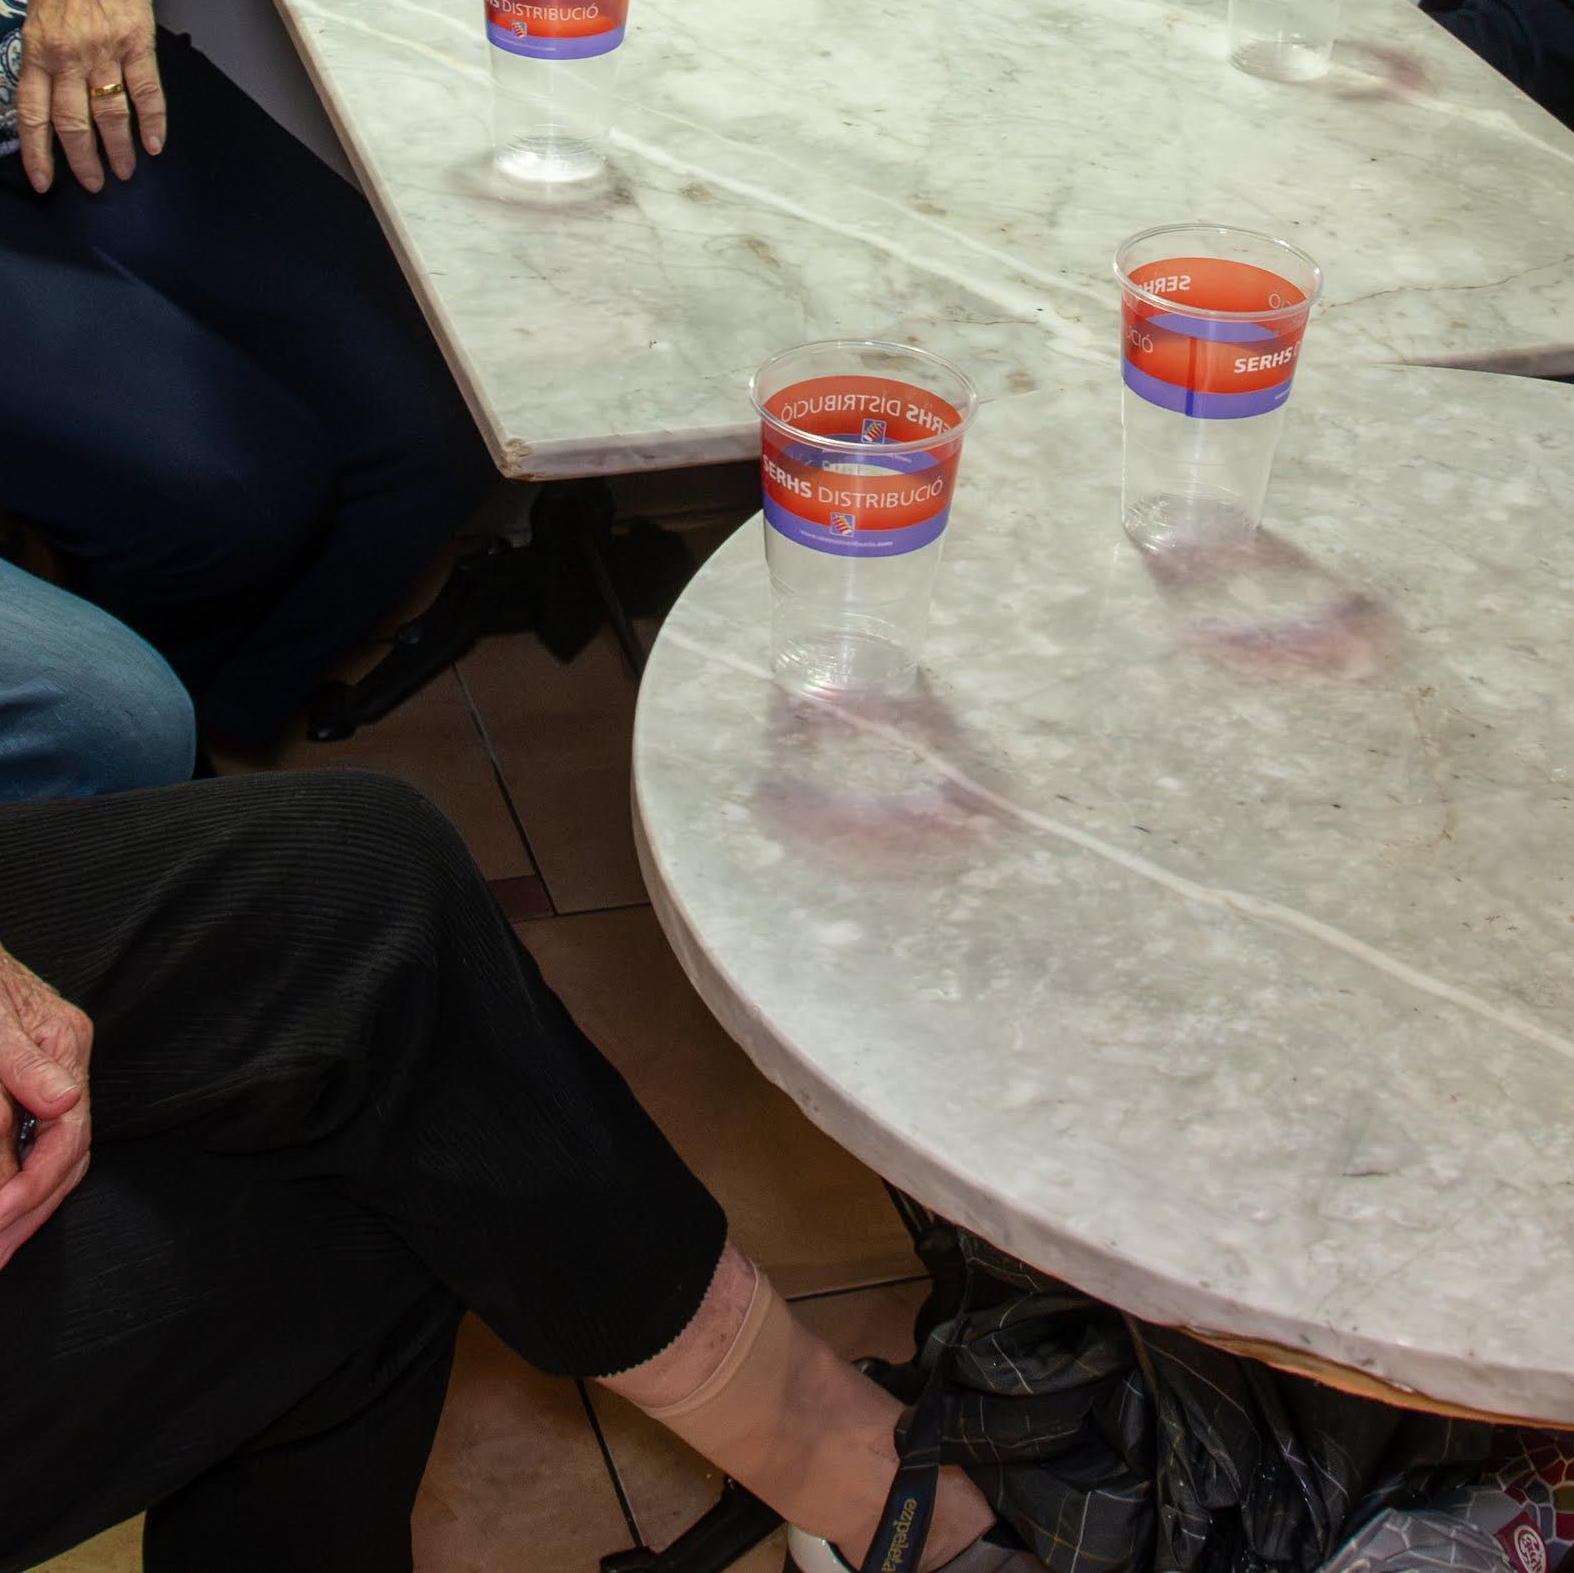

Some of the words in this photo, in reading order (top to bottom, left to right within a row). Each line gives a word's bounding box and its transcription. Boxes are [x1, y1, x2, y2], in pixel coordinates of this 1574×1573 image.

[1234, 346, 1294, 374] SERHS
[762, 454, 812, 499] SERHS
[818, 476, 943, 510] DISTRIBUCIÓ
